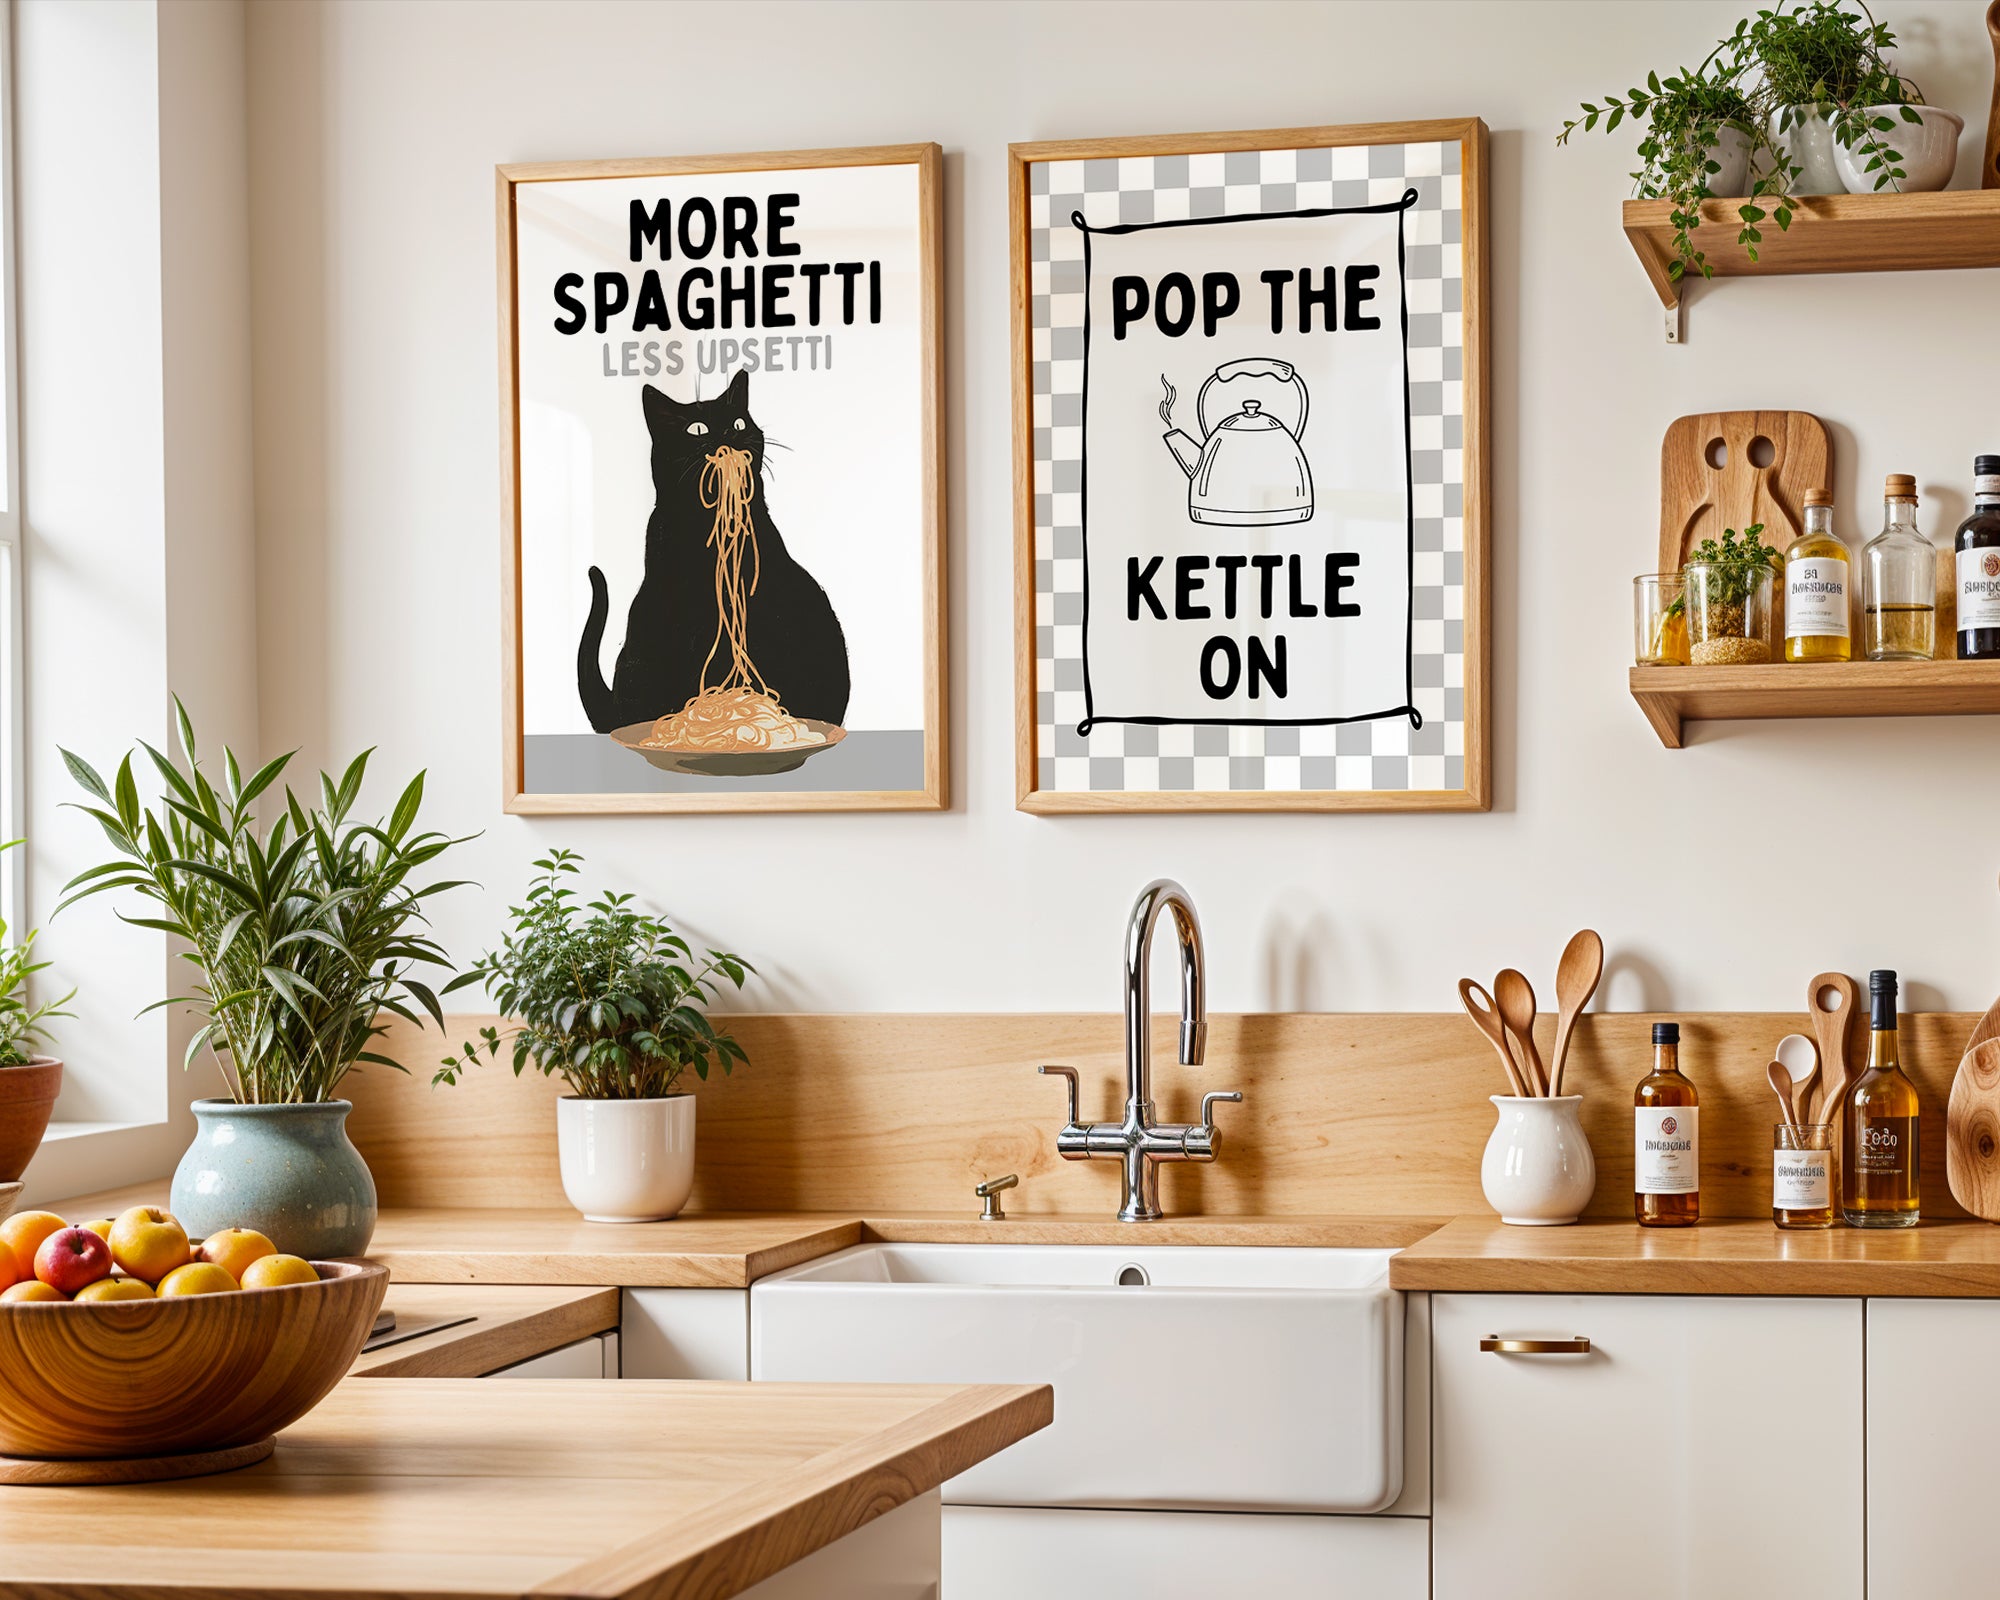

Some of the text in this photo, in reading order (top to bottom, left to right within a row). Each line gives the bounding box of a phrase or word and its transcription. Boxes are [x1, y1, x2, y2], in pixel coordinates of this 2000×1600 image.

[630, 193, 801, 262] MORE
[554, 261, 881, 335] SPAGHETTI
[1112, 264, 1381, 341] POP THE
[603, 335, 832, 376] LESS UPSETTI
[1127, 552, 1361, 621] KETTLE
[1200, 634, 1288, 700] ON
